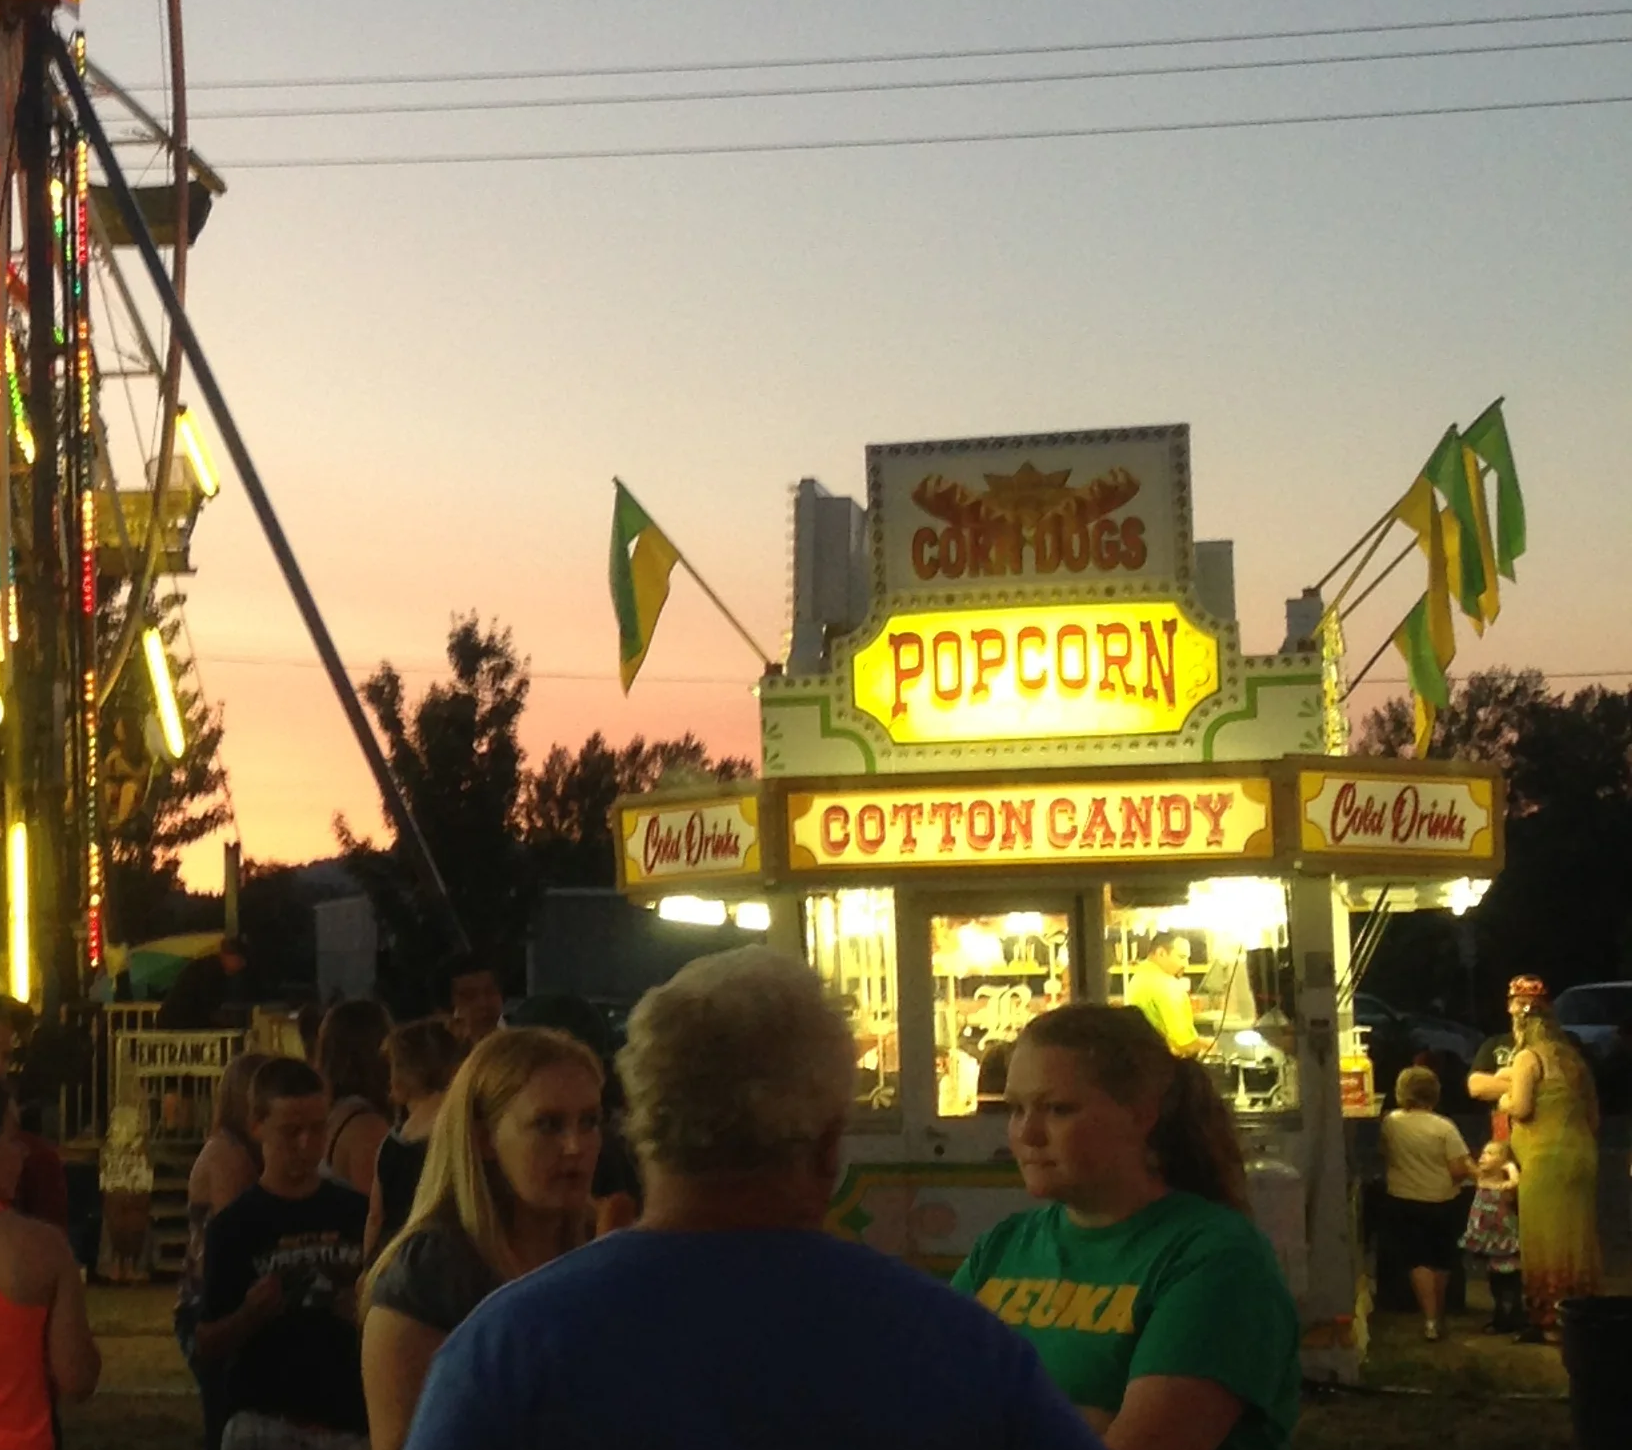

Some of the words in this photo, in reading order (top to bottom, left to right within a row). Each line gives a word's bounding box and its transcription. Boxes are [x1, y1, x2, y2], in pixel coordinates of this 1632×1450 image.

[911, 513, 1023, 581] CORN
[1034, 514, 1147, 575] DOGS
[888, 617, 1178, 724] POPCORN
[643, 813, 681, 875] Cold
[685, 810, 740, 867] Drinks
[819, 798, 1036, 856] COTTON
[1047, 792, 1235, 849] CANDY
[1330, 781, 1387, 845] Cold
[1391, 785, 1466, 843] Drinks
[135, 1039, 218, 1066] ENTRANCE
